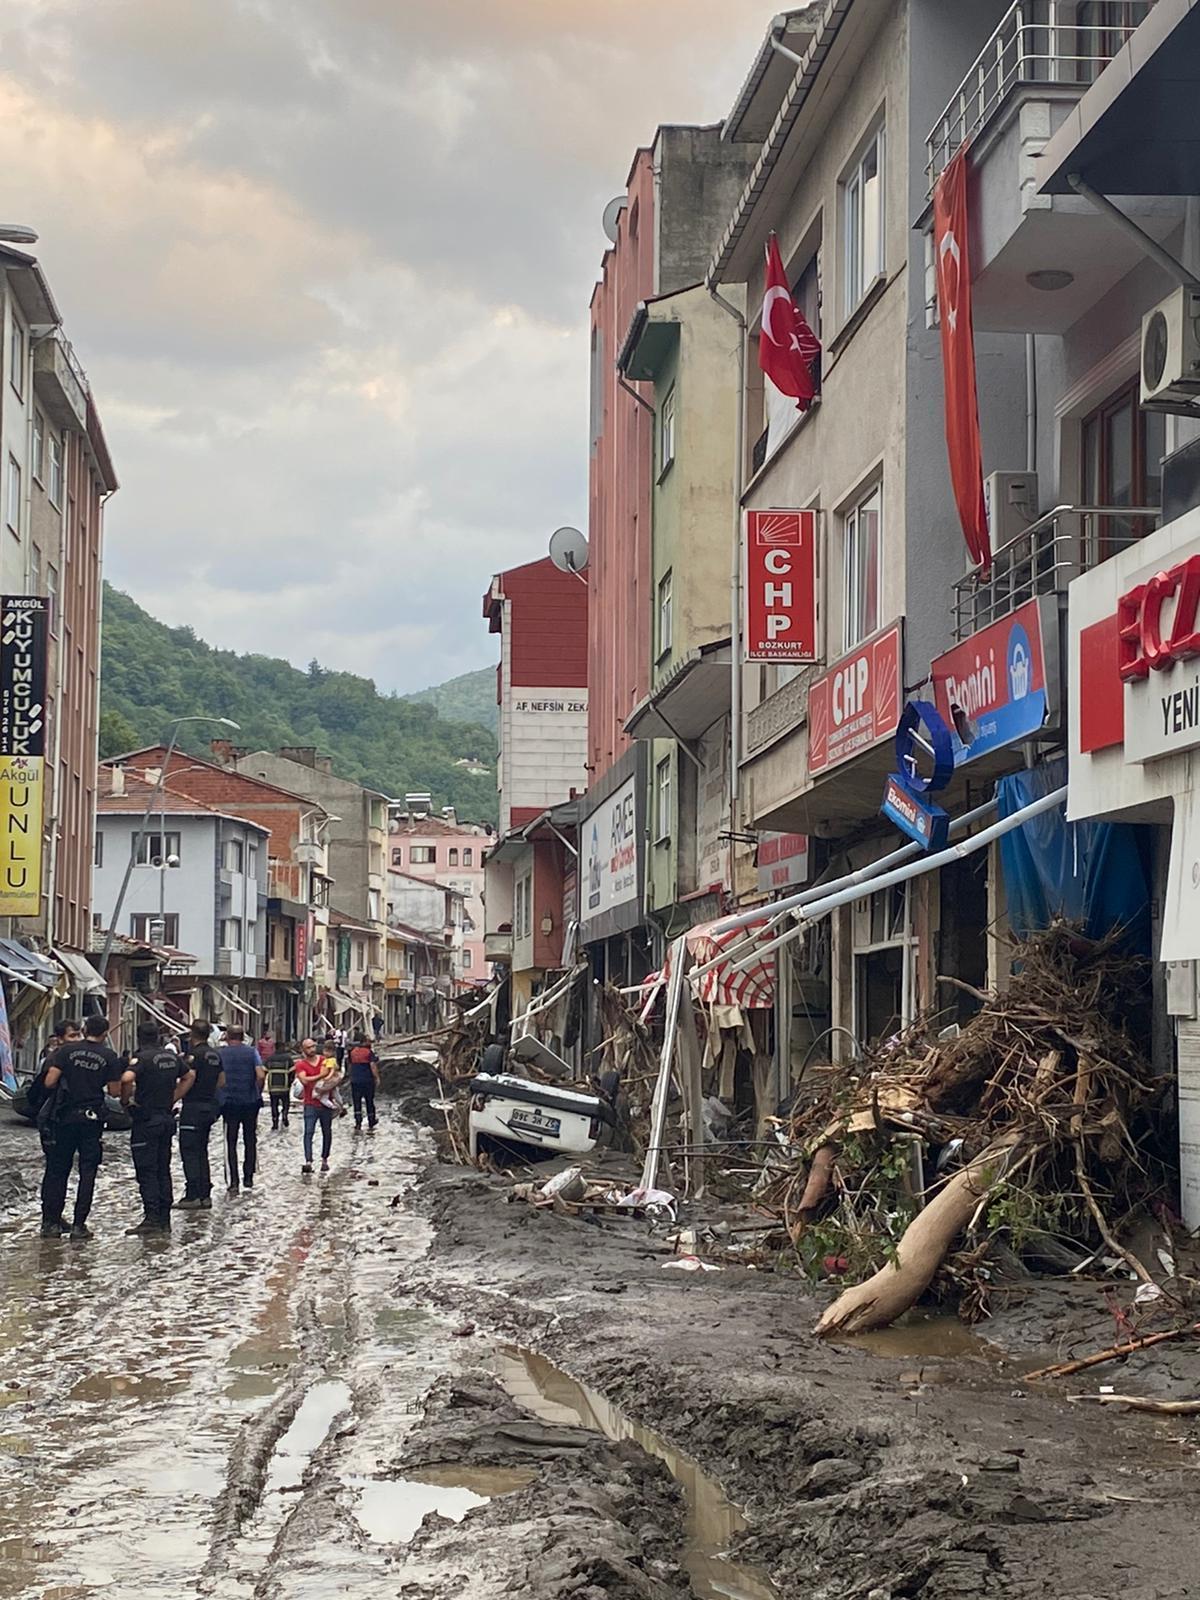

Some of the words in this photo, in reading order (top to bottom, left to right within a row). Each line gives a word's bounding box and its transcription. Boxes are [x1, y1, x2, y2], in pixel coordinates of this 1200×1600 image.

[7, 599, 44, 609] AKGÜL
[764, 549, 792, 640] CHP
[12, 610, 34, 754] KUYUMCULUK
[758, 641, 802, 650] BOZKURT
[832, 656, 869, 727] CHP
[945, 647, 996, 726] Ekomini
[0, 768, 39, 784] Akgül
[7, 786, 29, 888] UNLU
